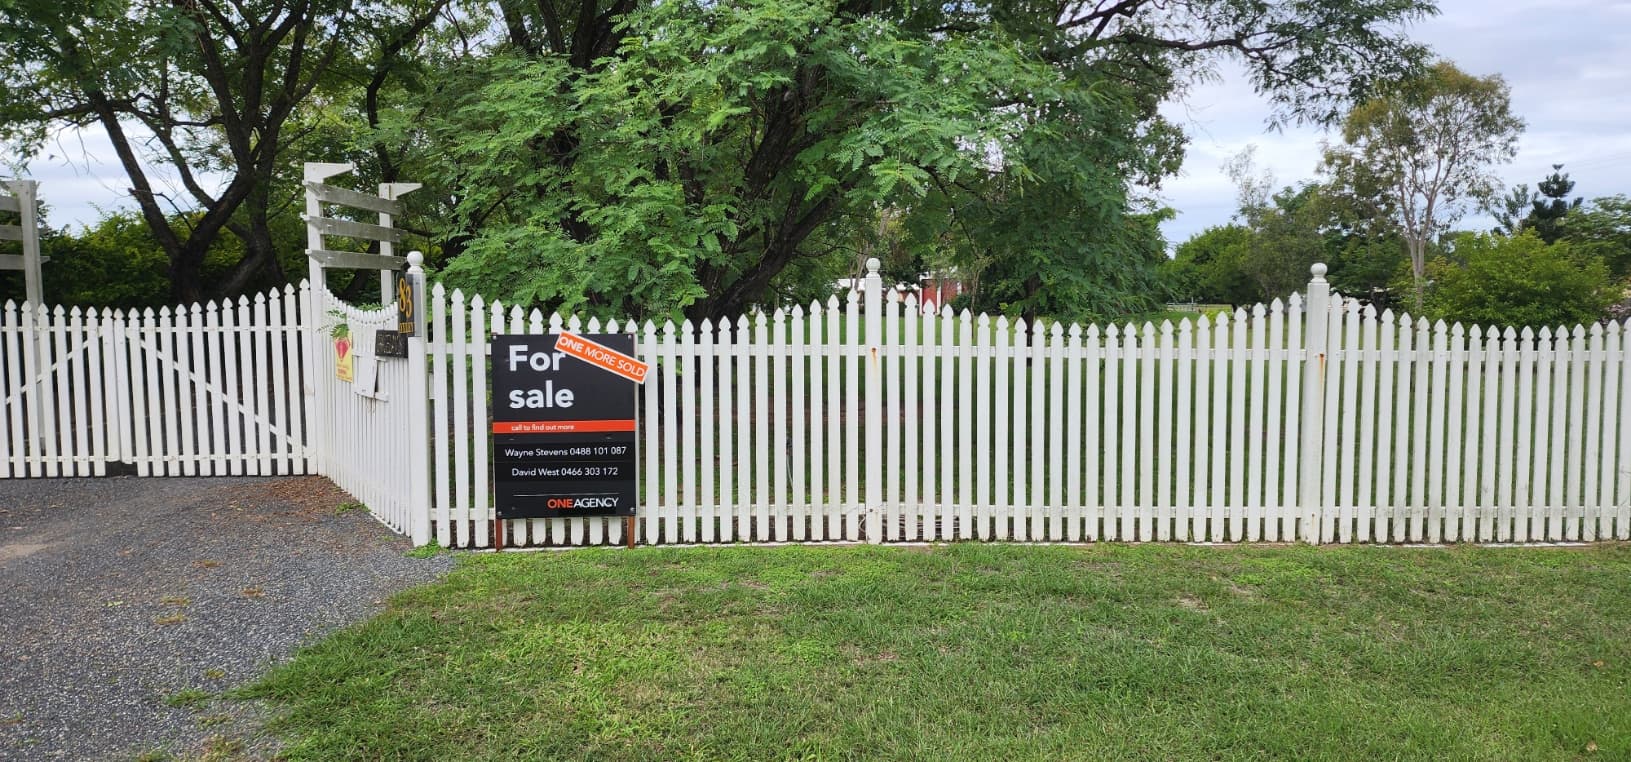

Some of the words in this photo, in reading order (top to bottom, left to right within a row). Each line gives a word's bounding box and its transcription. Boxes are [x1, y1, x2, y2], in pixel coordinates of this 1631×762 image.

[509, 345, 566, 371] For
[558, 336, 583, 353] ONE
[585, 345, 616, 366] MORE
[617, 359, 645, 377] SOLD
[509, 380, 574, 408] sale
[531, 423, 544, 431] find
[505, 449, 534, 458] Wayne
[535, 448, 568, 457] Stevens
[570, 447, 591, 455] 0488
[594, 447, 608, 455] 101
[610, 446, 627, 455] 087
[511, 468, 537, 476] David
[537, 468, 559, 476] West
[561, 468, 582, 476] 0466
[585, 468, 600, 476] 303
[603, 467, 618, 475] 172
